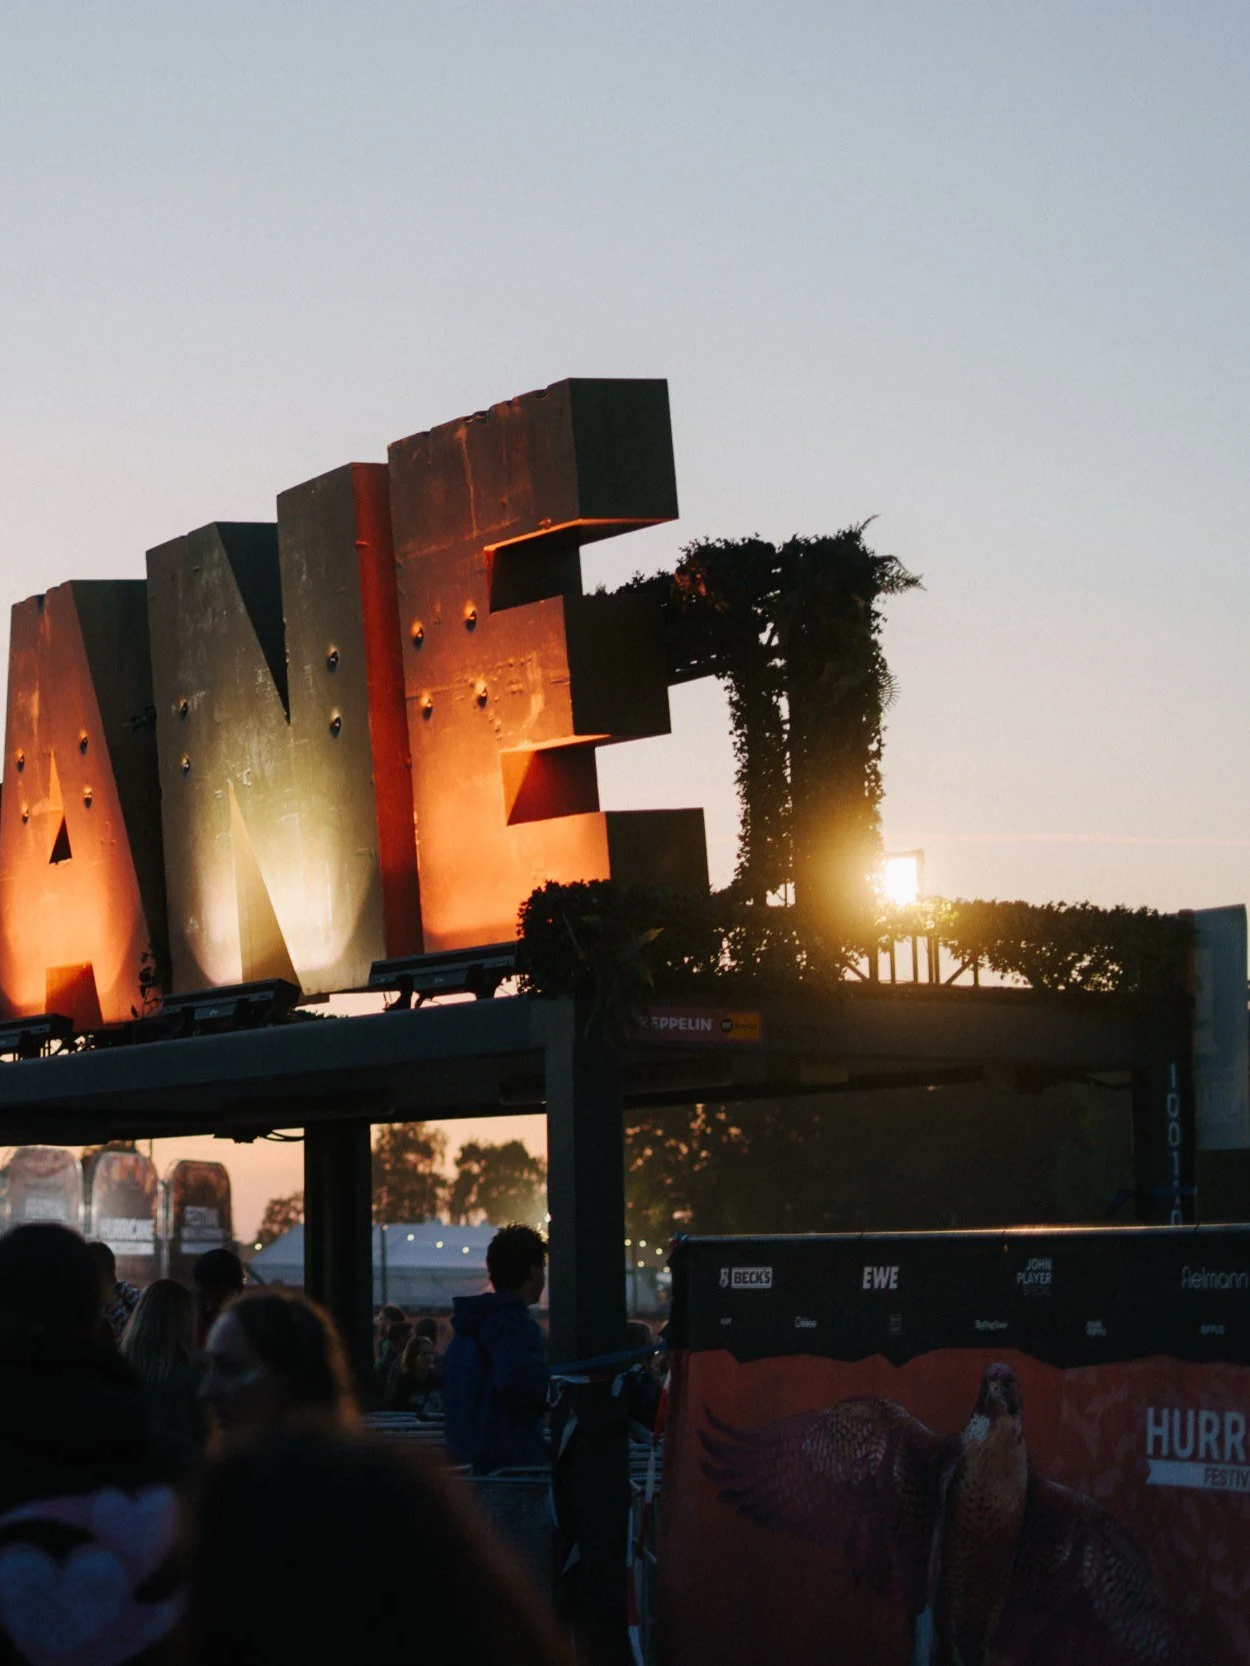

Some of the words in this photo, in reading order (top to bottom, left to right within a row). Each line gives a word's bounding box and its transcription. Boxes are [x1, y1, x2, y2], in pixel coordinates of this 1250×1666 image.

[1025, 1258, 1052, 1271] JOHN
[734, 1270, 771, 1285] BECK'S
[862, 1265, 900, 1290] EWE
[1016, 1272, 1052, 1285] PLAYER
